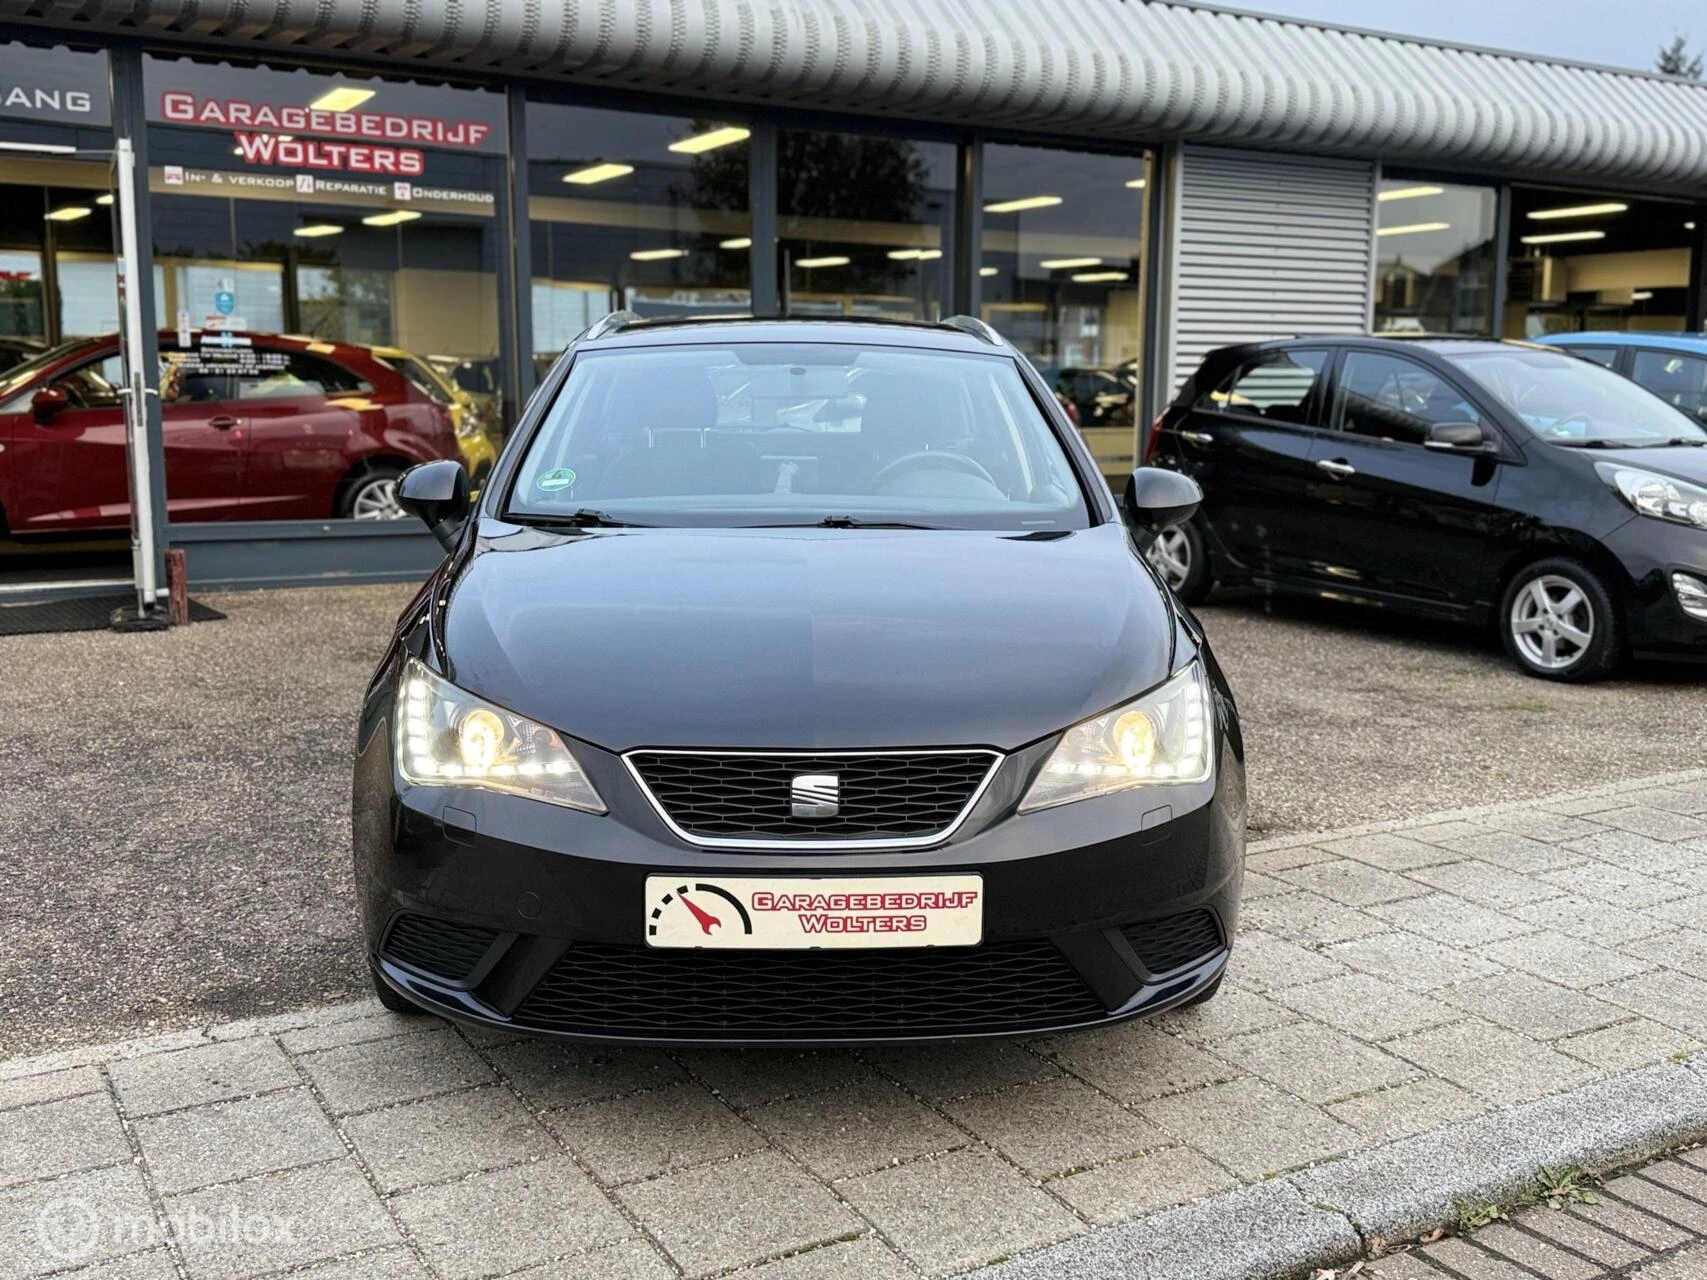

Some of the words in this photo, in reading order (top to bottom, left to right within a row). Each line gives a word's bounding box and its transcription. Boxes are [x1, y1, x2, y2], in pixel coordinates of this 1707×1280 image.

[0, 86, 91, 112] ANG
[162, 91, 490, 146] GARAGEBEDRIJF
[235, 132, 424, 175] WOLTERS
[211, 172, 223, 184] &
[228, 175, 295, 188] VERKOOP
[315, 181, 387, 195] REPARATIE
[412, 187, 494, 203] ONDERHOUD
[752, 891, 978, 911] GARAGEBEDRIJF
[798, 914, 927, 933] WOLTERS
